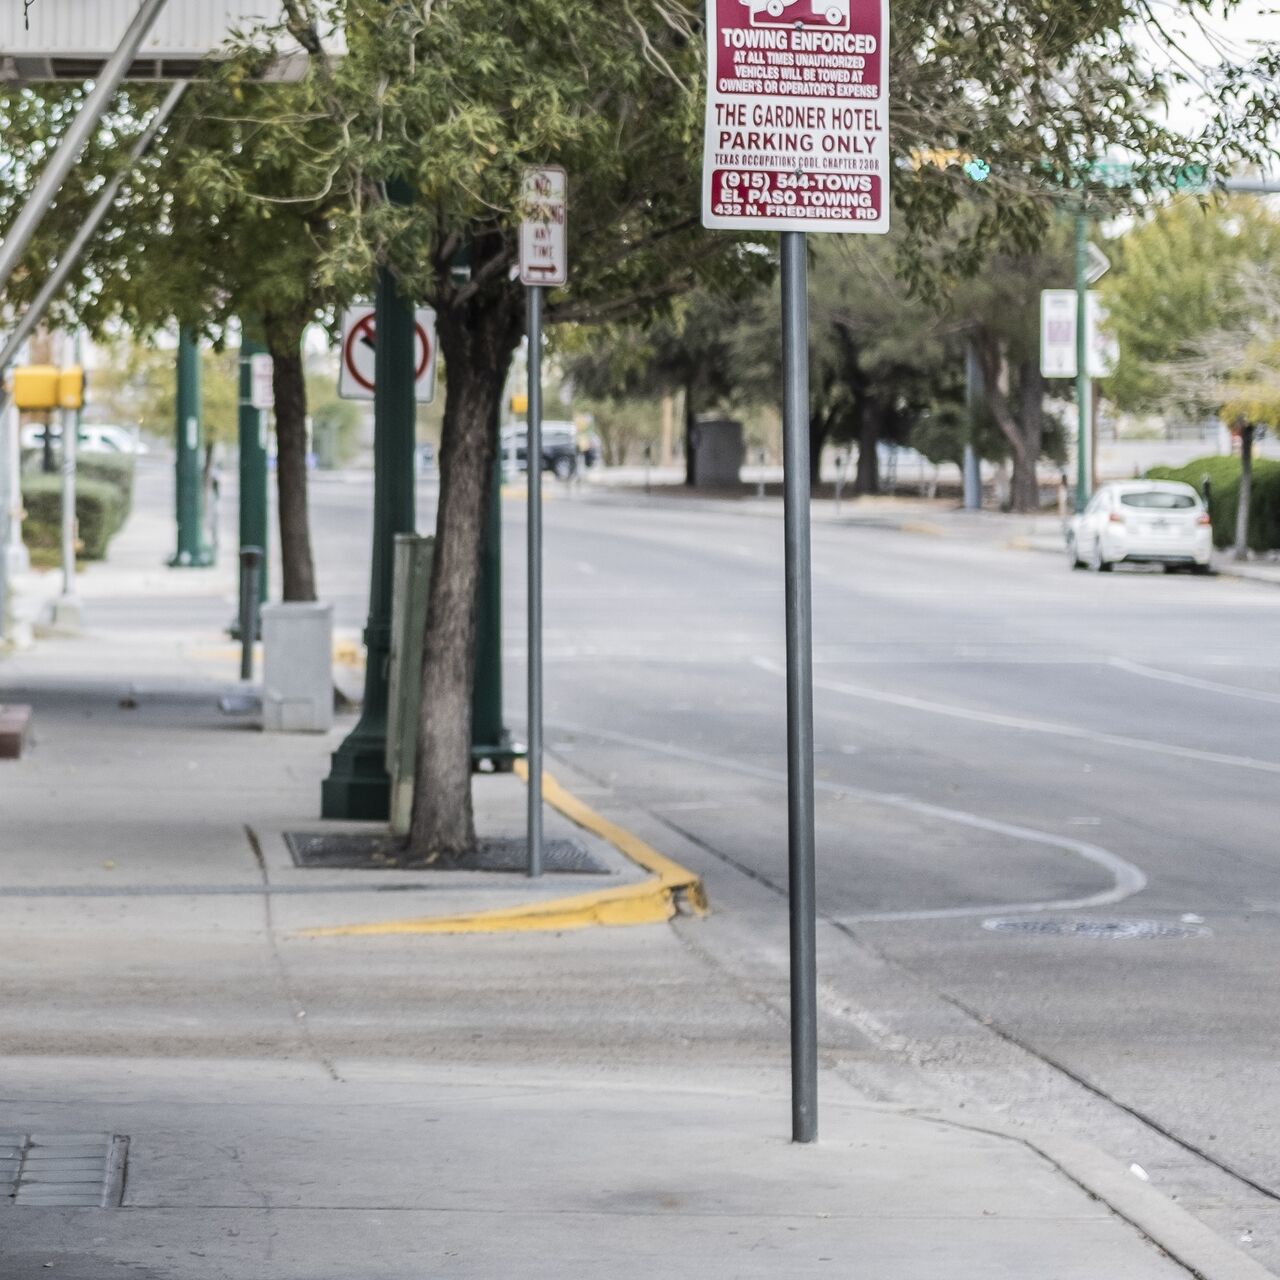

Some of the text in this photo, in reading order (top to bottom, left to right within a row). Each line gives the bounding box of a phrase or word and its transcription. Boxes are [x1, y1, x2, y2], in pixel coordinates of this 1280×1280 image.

[721, 28, 877, 54] TOWING ENFORCED
[733, 50, 865, 69] AT ALL TIMES UNAUTHORIZED
[734, 65, 864, 83] VEHICLES WILL BE TOWED AT
[719, 78, 878, 98] OWNER'S OR OPERATOR'S EXPENSE
[715, 103, 882, 131] THE GARDNER HOTEL
[719, 131, 876, 153] PARKING ONLY
[714, 153, 740, 166] TEXAS
[741, 154, 796, 167] OCCUPATIONS
[823, 157, 858, 170] CHAPTER
[859, 159, 880, 171] 2308
[720, 171, 872, 192] (915) 544-TOWS
[720, 188, 872, 207] EL PASO TOWING
[714, 204, 878, 220] 432 N. FREDERICK RD
